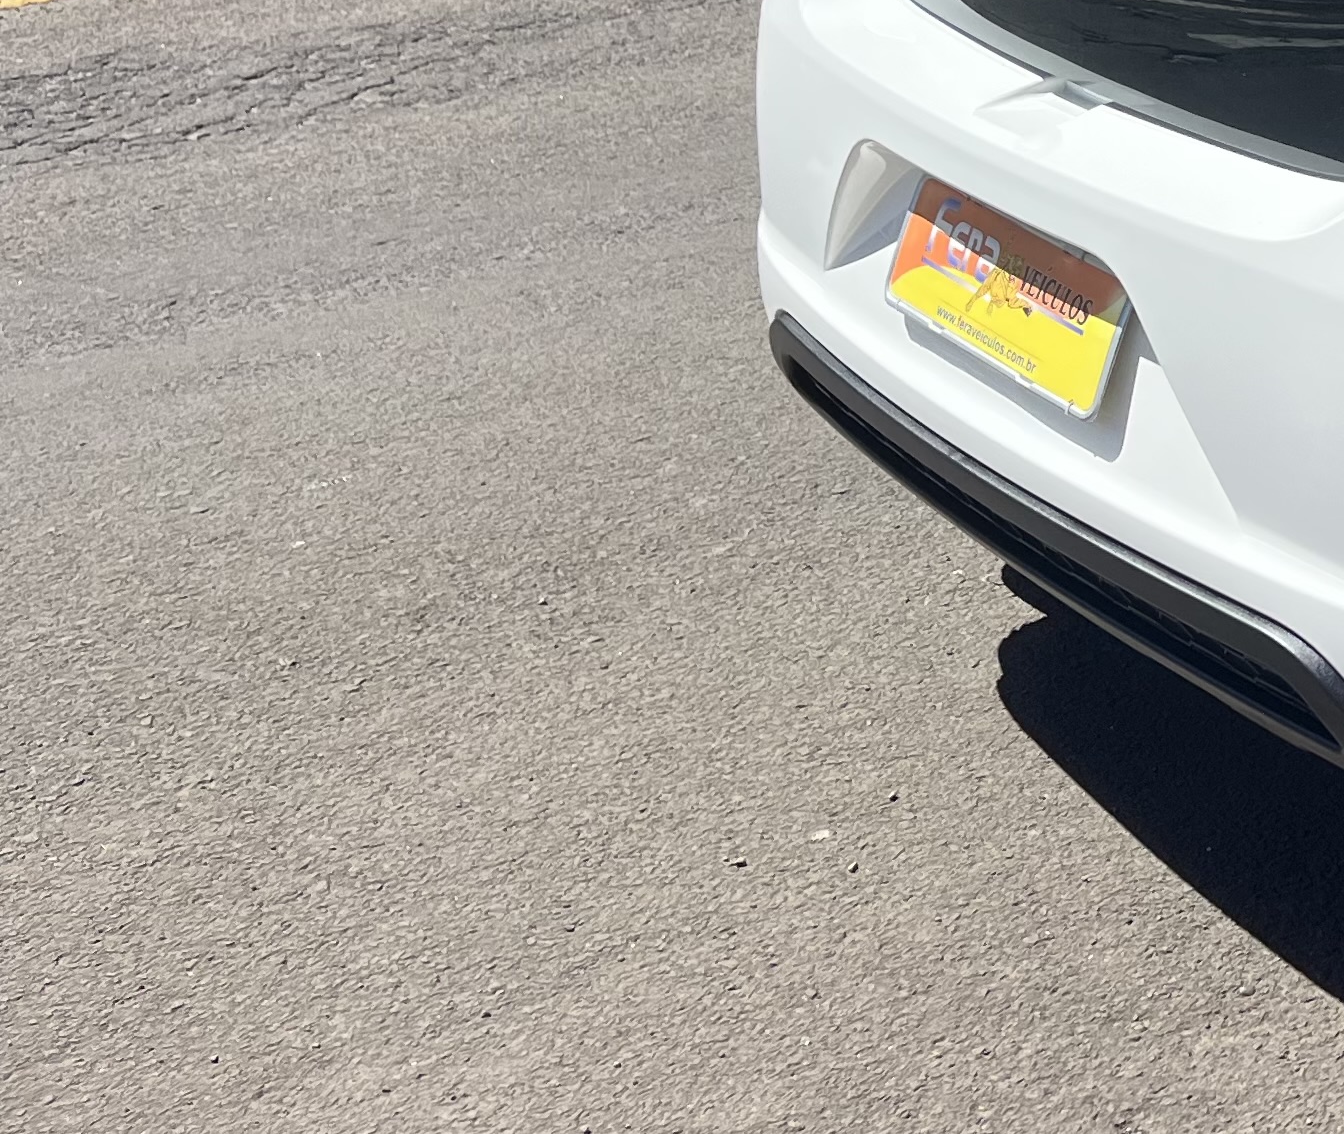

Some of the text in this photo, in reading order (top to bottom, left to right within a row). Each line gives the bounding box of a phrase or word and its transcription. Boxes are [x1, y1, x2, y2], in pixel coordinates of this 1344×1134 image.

[924, 197, 1094, 326] Fera VEÍCULOS
[935, 304, 1038, 374] www.feraveiculos.com.br
